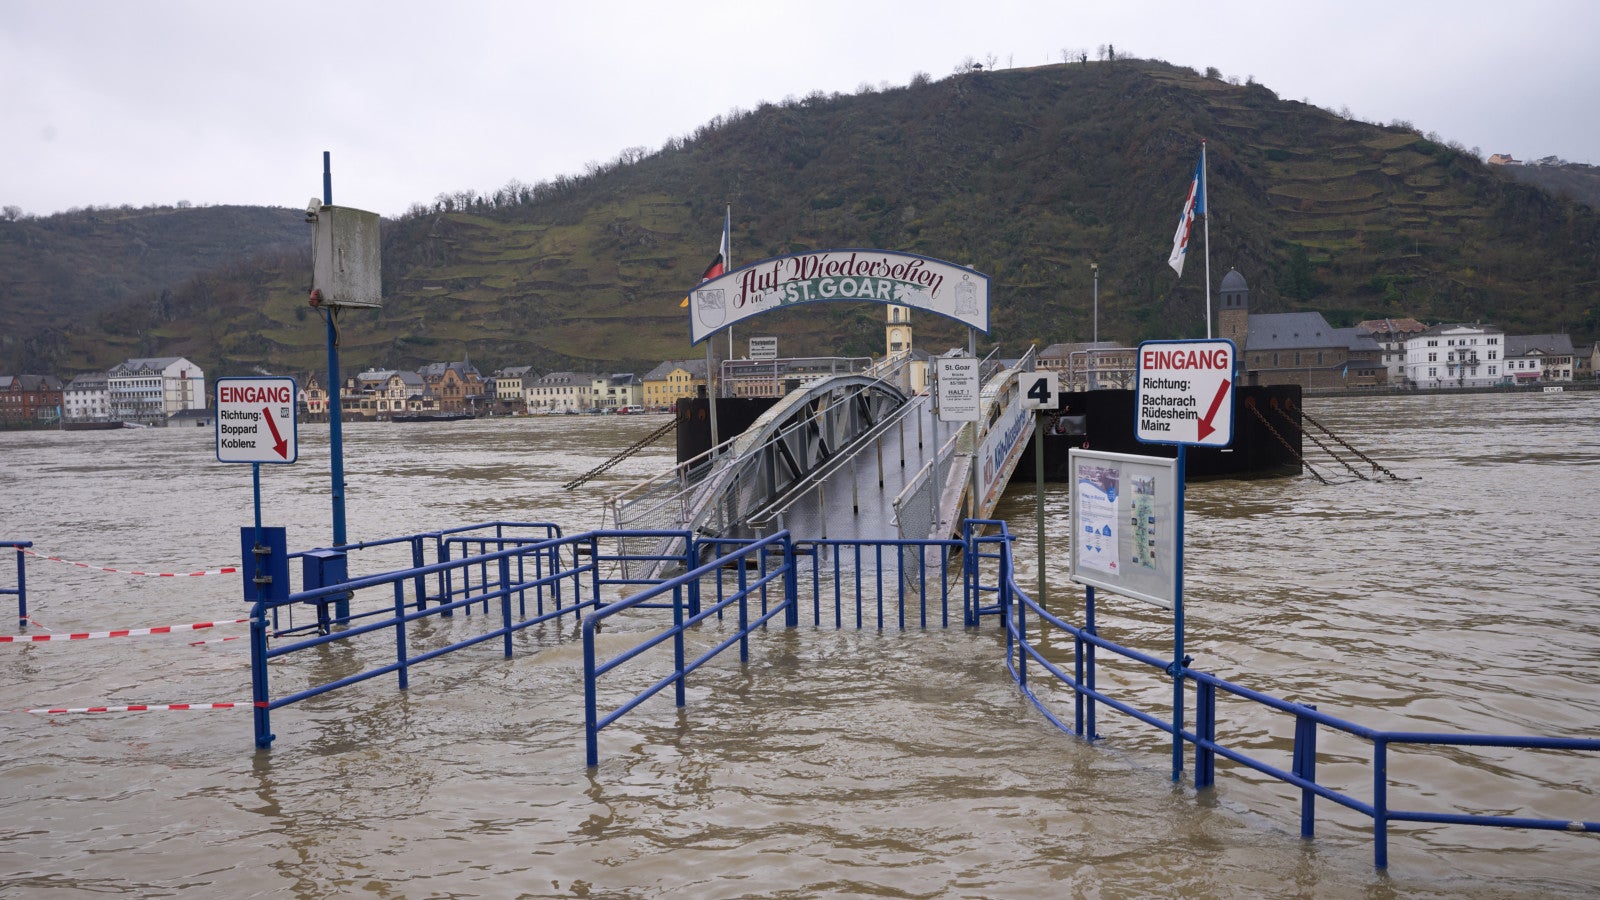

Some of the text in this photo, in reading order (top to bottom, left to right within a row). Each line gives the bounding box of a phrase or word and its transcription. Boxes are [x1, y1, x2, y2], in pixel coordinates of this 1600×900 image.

[733, 252, 944, 309] Auf Wiedersehen
[750, 278, 892, 304] in ST. GOAR
[1143, 349, 1228, 370] EINGANG
[1027, 377, 1052, 404] 4
[1143, 377, 1191, 391] Richtung:
[220, 386, 290, 403] EINGANG
[1142, 394, 1196, 407] Bacharach
[221, 410, 262, 422] Richtung:
[1141, 406, 1198, 420] Rüdesheim
[221, 424, 258, 436] Boppard
[1141, 419, 1171, 431] Mainz
[221, 438, 257, 449] Koblenz
